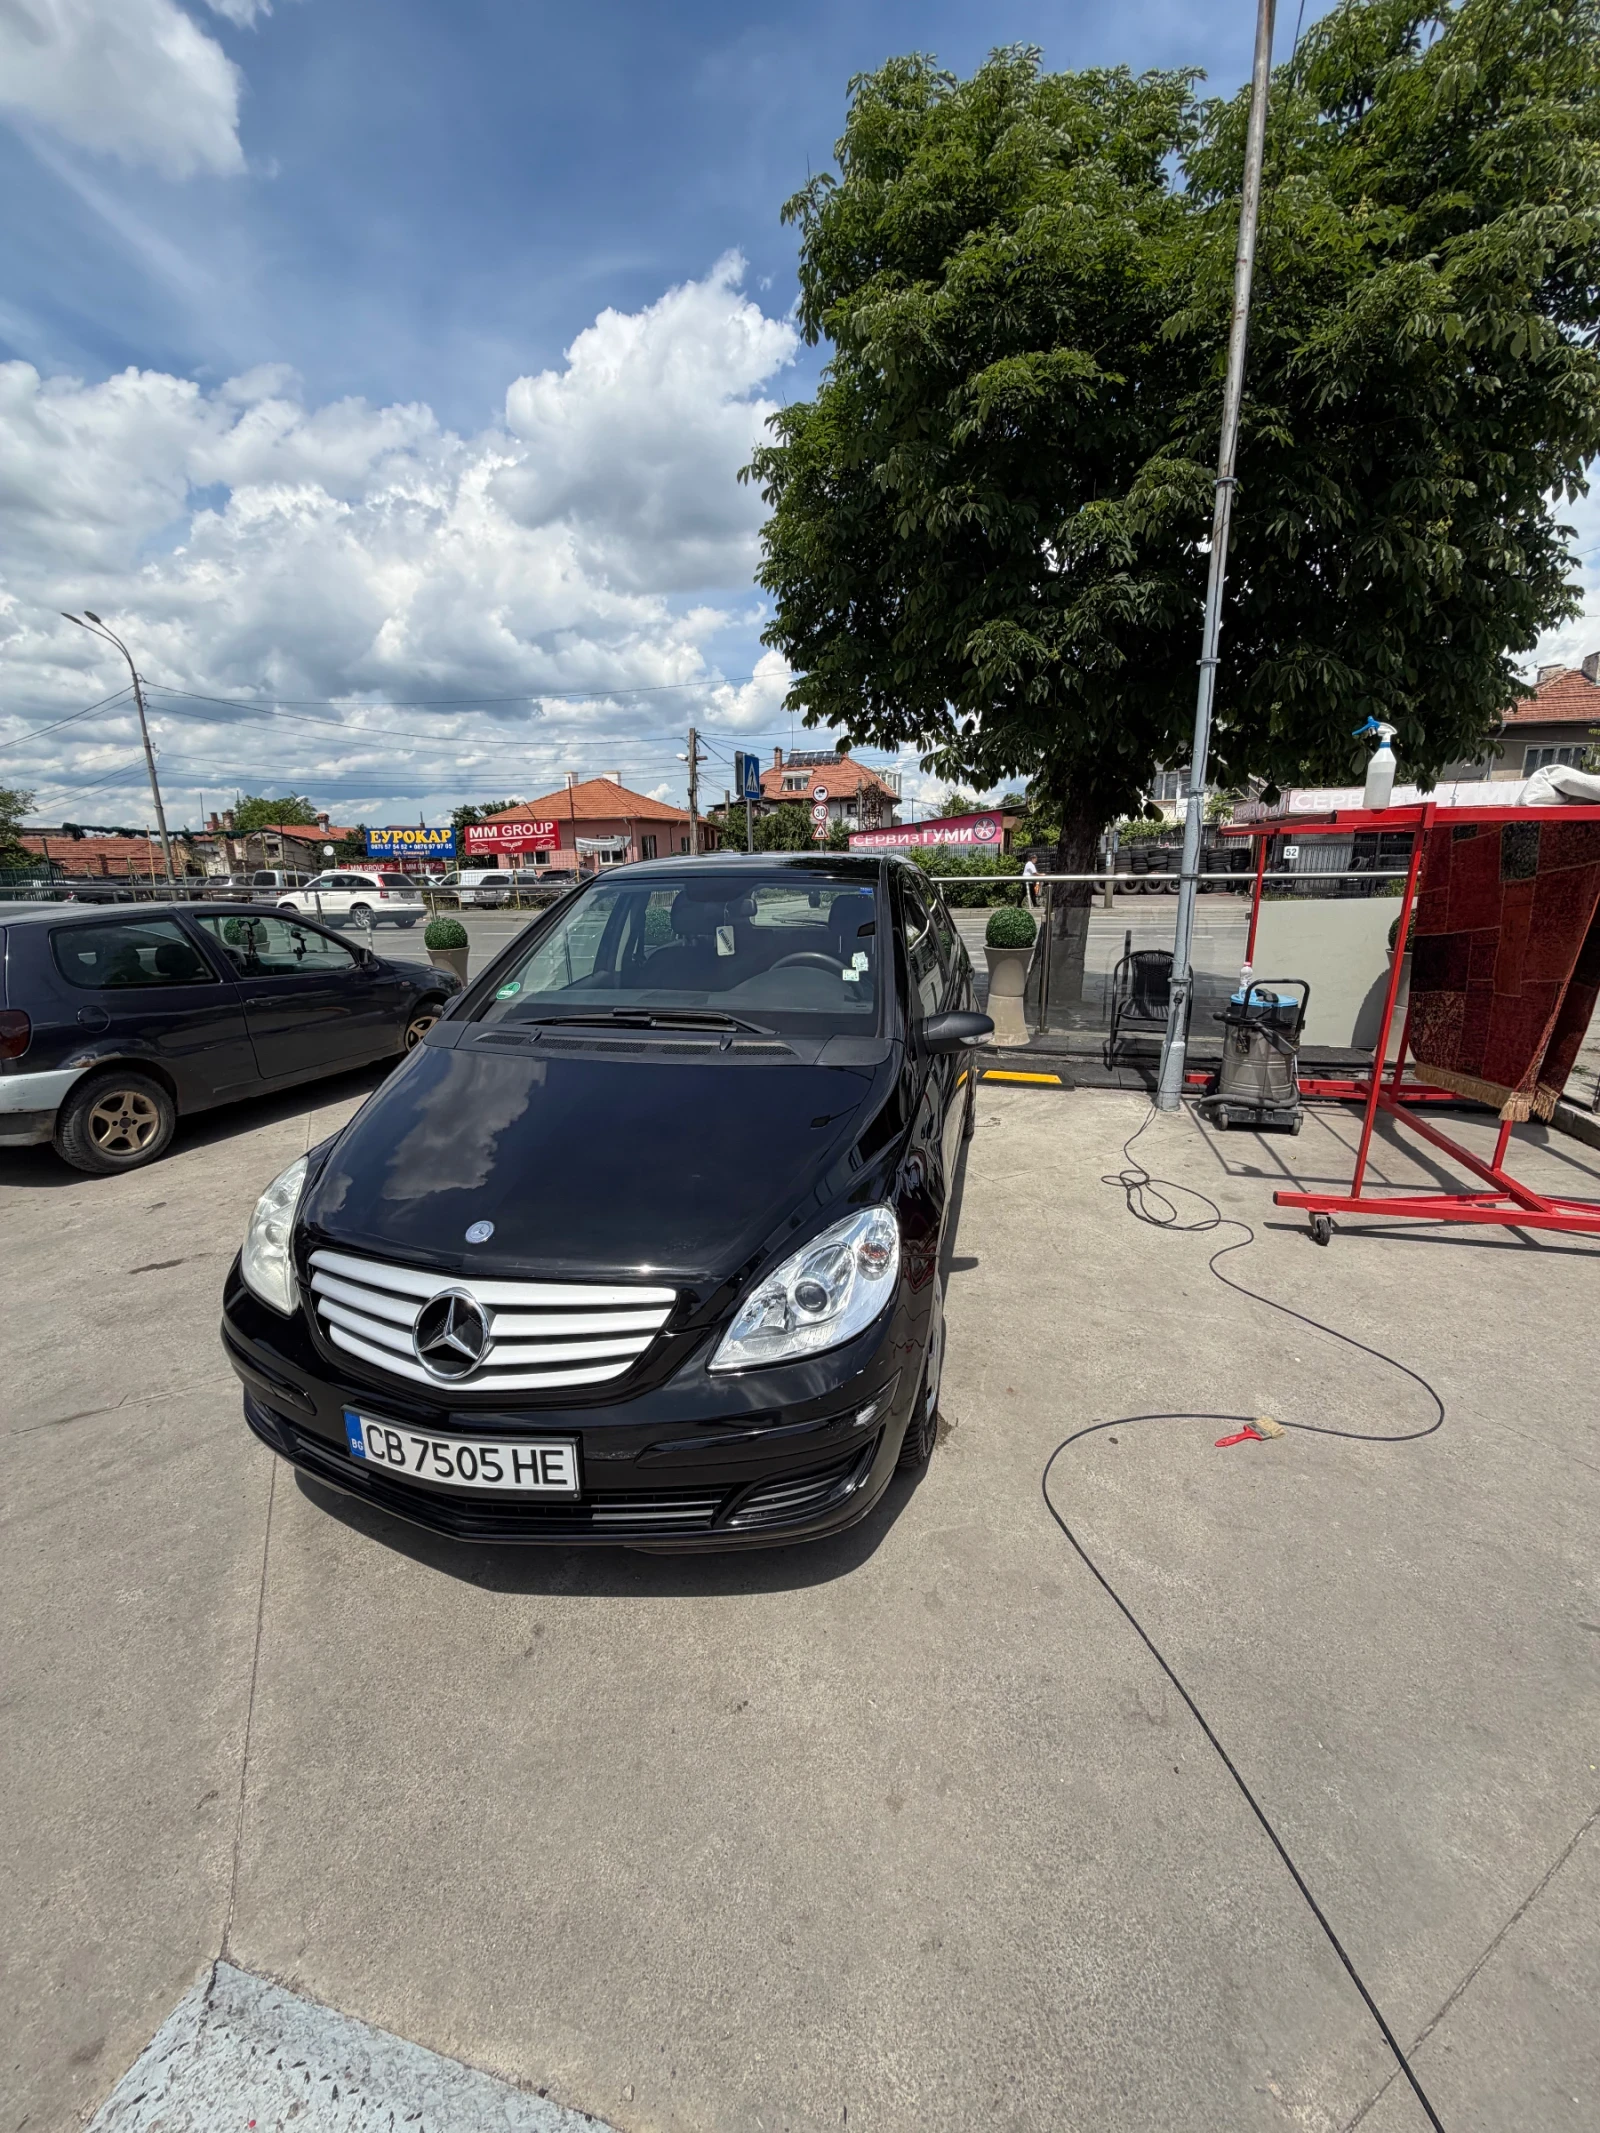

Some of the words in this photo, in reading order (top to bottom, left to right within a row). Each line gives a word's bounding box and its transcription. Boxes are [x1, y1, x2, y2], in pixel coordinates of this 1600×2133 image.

[815, 808, 825, 818] 30
[369, 829, 452, 844] ЕУРОКАР
[469, 826, 498, 839] MM
[501, 822, 554, 836] GROUP
[853, 833, 920, 845] СЕРВИЗ
[923, 828, 974, 842] ГУМИ
[1285, 848, 1297, 857] 52
[363, 864, 385, 872] GROUP
[351, 1438, 364, 1451] BG
[365, 1423, 406, 1466] CB
[410, 1436, 504, 1483] 7505
[512, 1448, 568, 1486] HE
